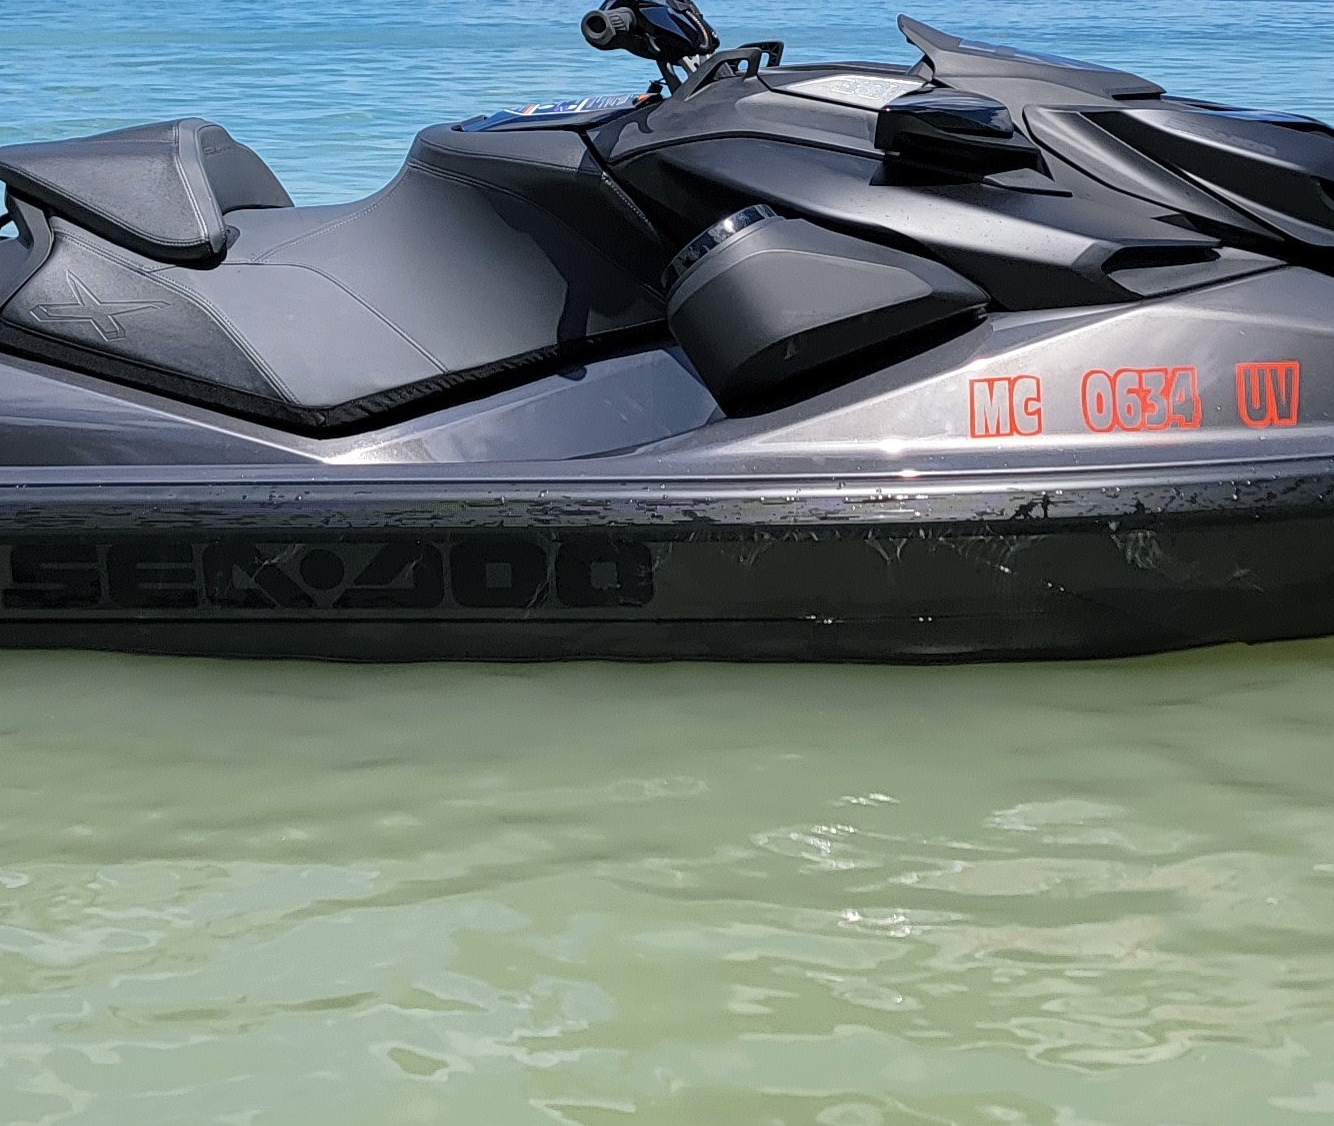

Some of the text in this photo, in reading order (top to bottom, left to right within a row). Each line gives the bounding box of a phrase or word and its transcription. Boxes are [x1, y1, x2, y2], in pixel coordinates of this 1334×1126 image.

[969, 362, 1300, 437] MC 0634 UV
